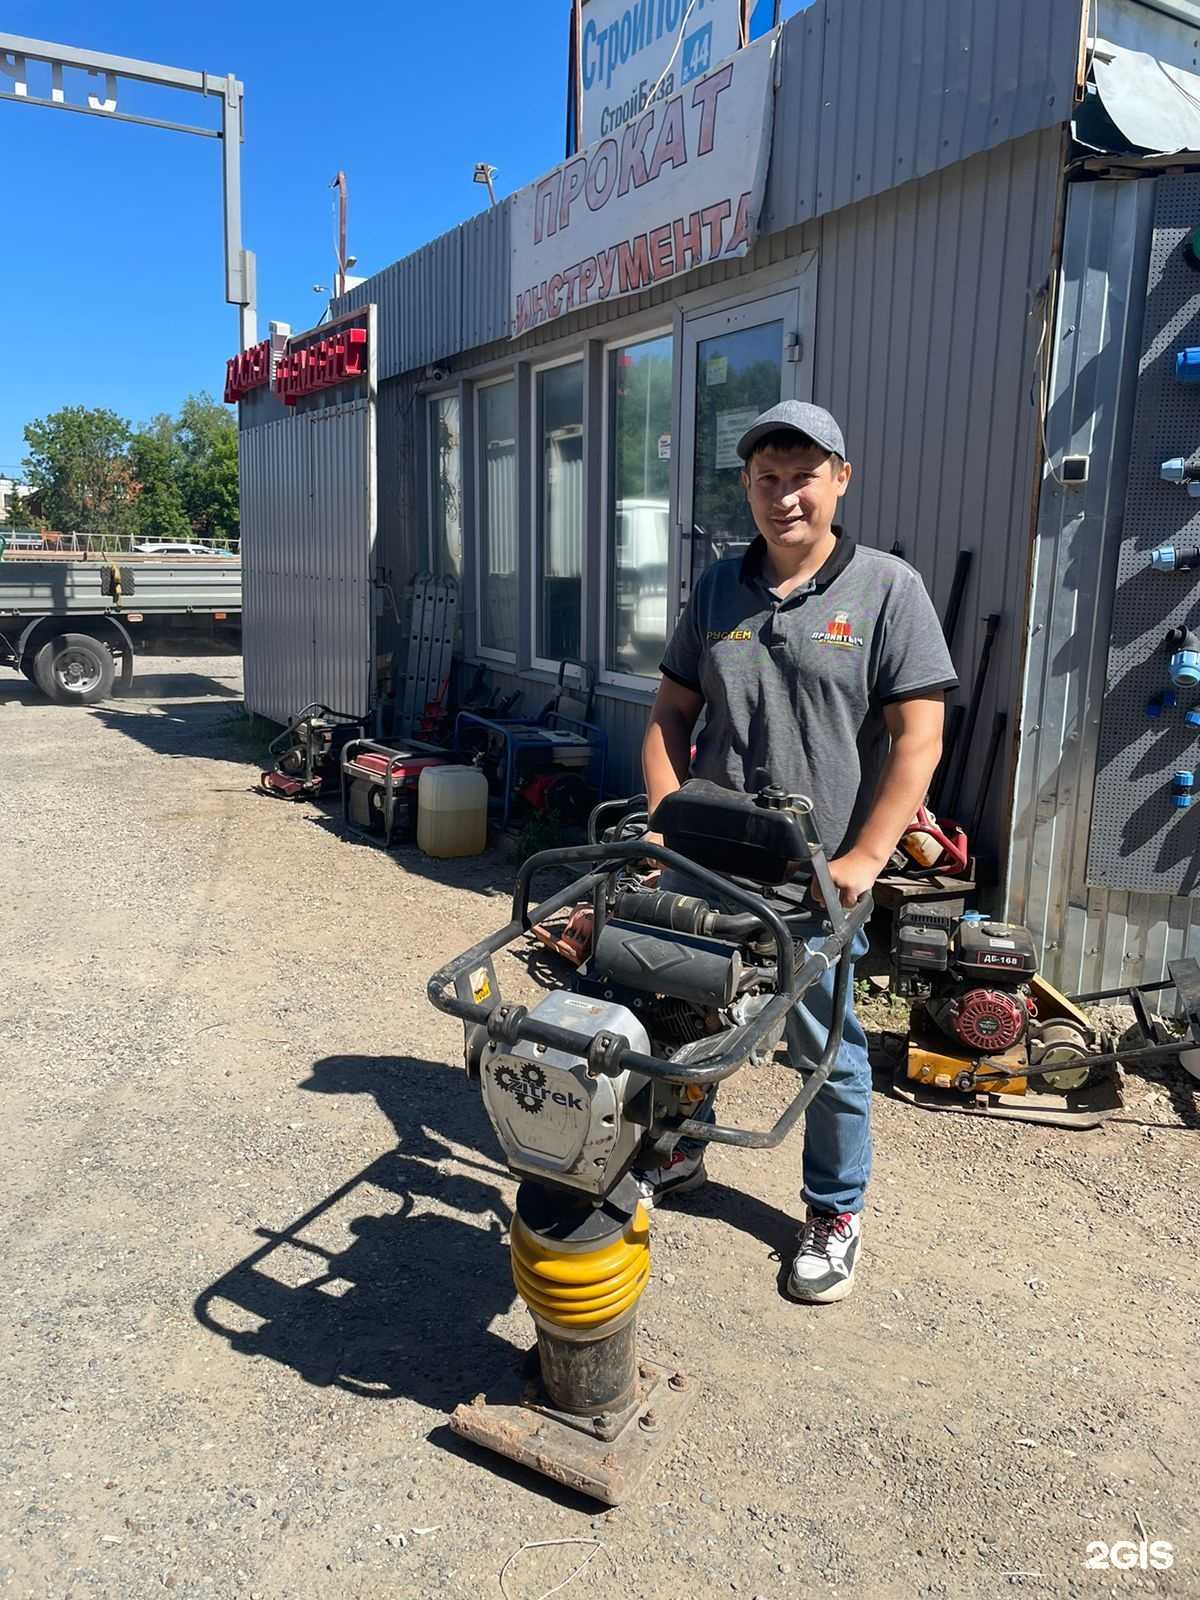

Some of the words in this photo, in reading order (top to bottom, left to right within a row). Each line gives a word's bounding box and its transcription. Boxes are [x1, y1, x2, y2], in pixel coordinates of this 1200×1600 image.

[533, 62, 734, 246] ПРОКАТ
[515, 190, 752, 334] ИНСТРУМЕНТА
[706, 630, 752, 640] РУСТЕМ
[983, 954, 1018, 965] ДБ-168
